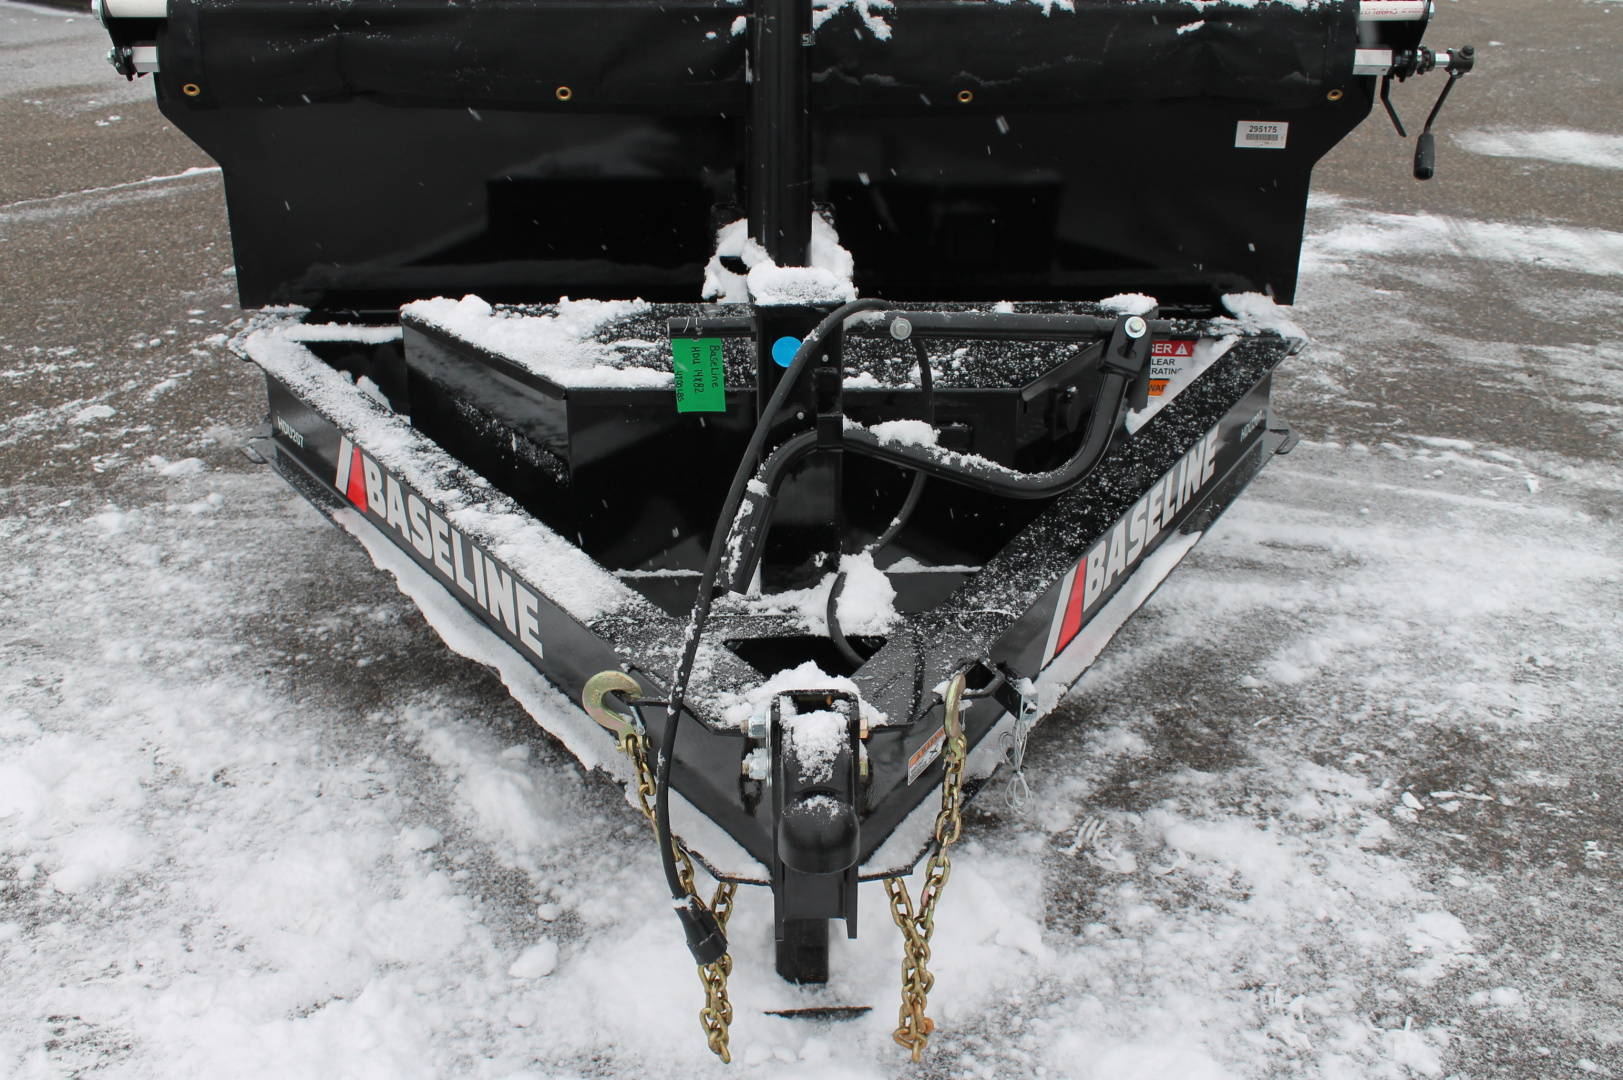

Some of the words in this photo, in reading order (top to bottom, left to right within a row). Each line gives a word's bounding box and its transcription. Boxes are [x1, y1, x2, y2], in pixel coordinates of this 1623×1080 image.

[1249, 125, 1277, 134] 295175
[691, 346, 701, 364] HDU
[1150, 367, 1182, 375] RATIN
[1083, 423, 1220, 613] BASELINE
[362, 453, 544, 660] BASELINE
